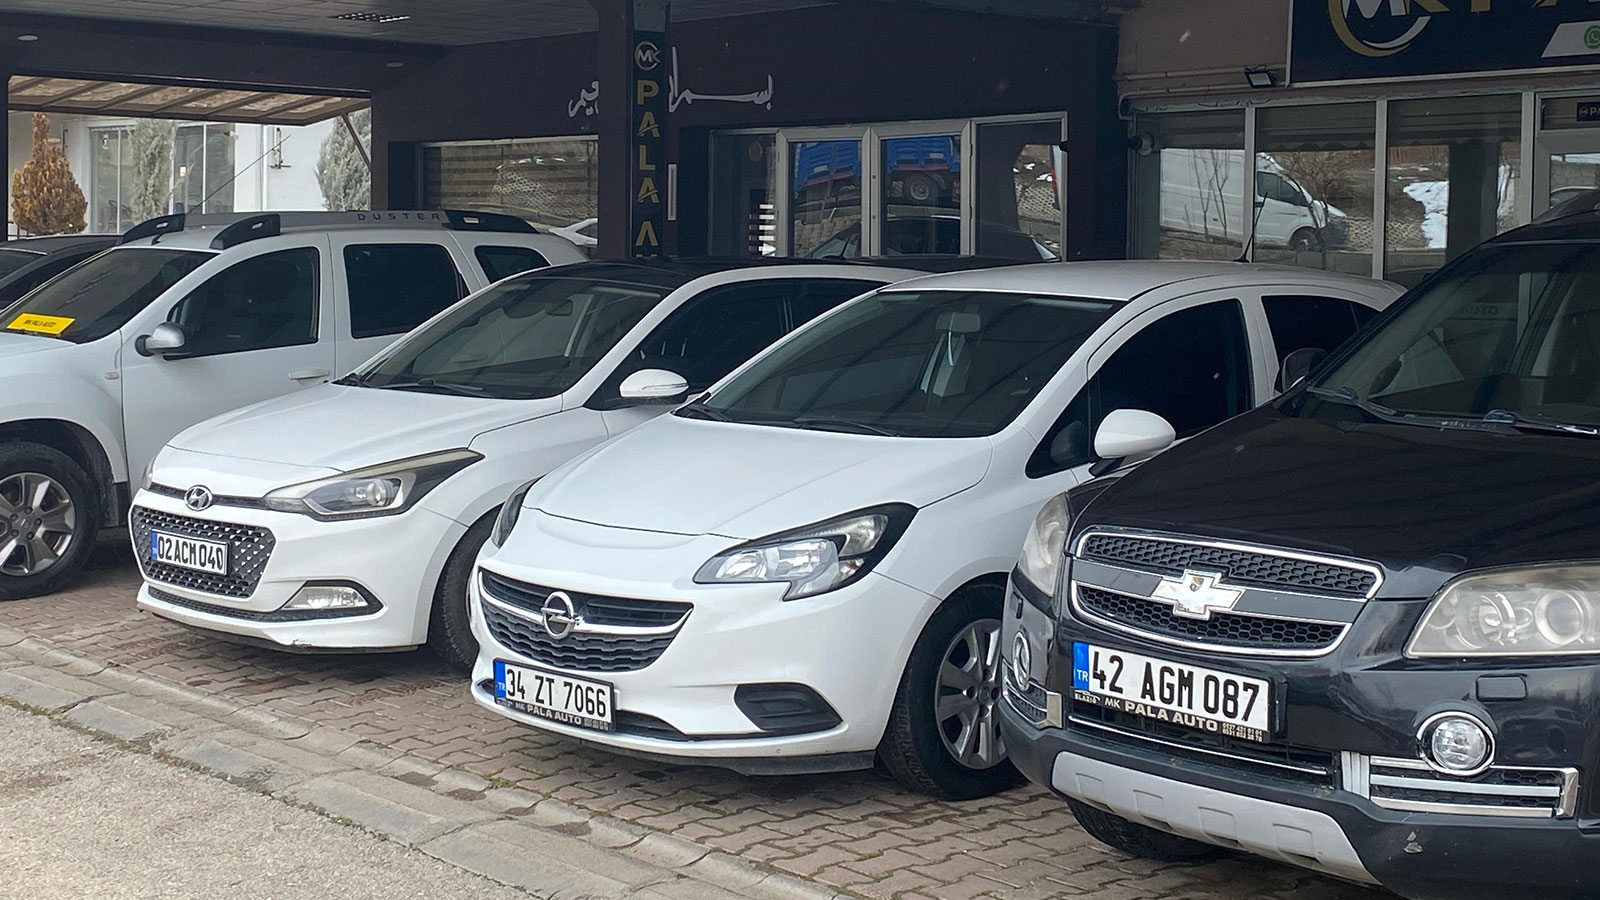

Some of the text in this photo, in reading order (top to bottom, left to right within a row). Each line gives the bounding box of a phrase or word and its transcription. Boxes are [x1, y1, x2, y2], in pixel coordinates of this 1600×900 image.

[636, 79, 661, 204] PALA
[357, 213, 440, 221] DUSTER
[158, 536, 173, 560] 02
[199, 544, 223, 570] 040
[498, 682, 506, 691] TR
[1076, 669, 1088, 682] TR
[1092, 651, 1260, 722] 42 AGM 087
[506, 668, 606, 718] 34 ZT 7066
[527, 704, 553, 718] PALA
[554, 711, 582, 725] AUTO
[1104, 697, 1218, 732] MK PALA AUTO
